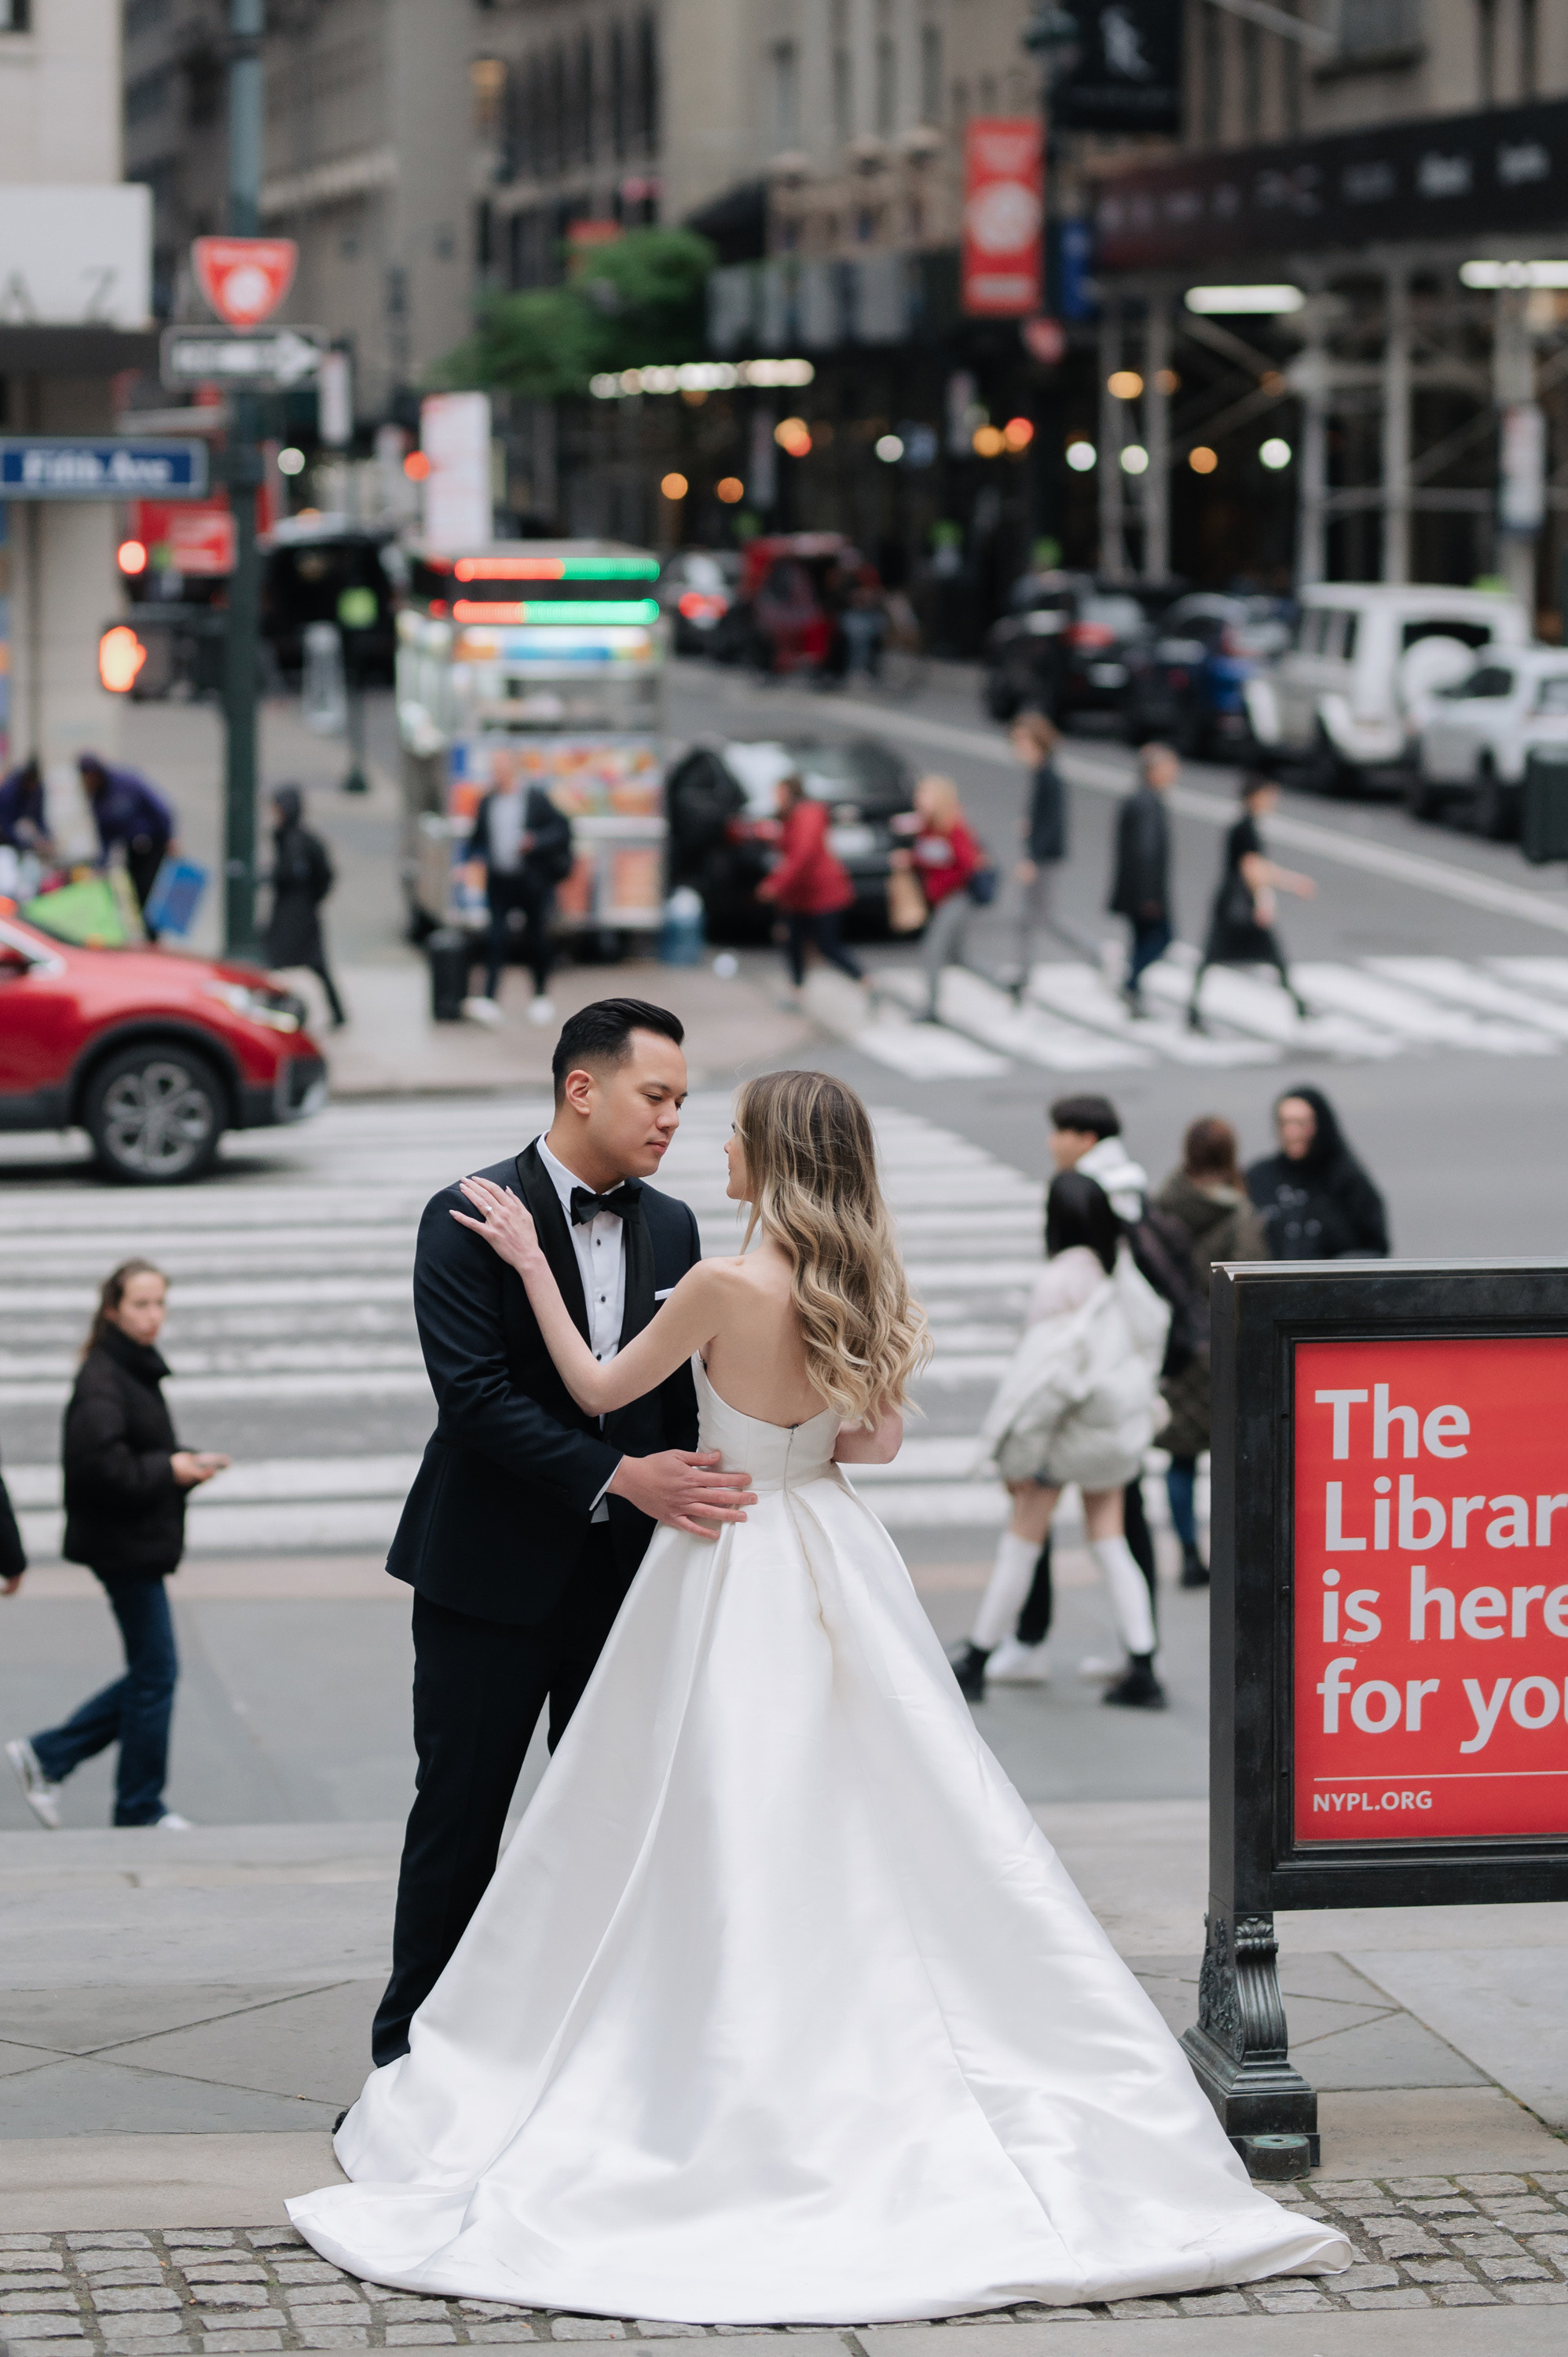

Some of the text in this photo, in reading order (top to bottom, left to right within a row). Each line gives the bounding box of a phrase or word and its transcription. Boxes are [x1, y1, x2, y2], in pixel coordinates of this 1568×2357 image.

[1314, 1383, 1471, 1460] The
[1322, 1565, 1568, 1644] is here
[1316, 1656, 1568, 1754] for yo
[1313, 1790, 1433, 1813] NYPL.ORG
